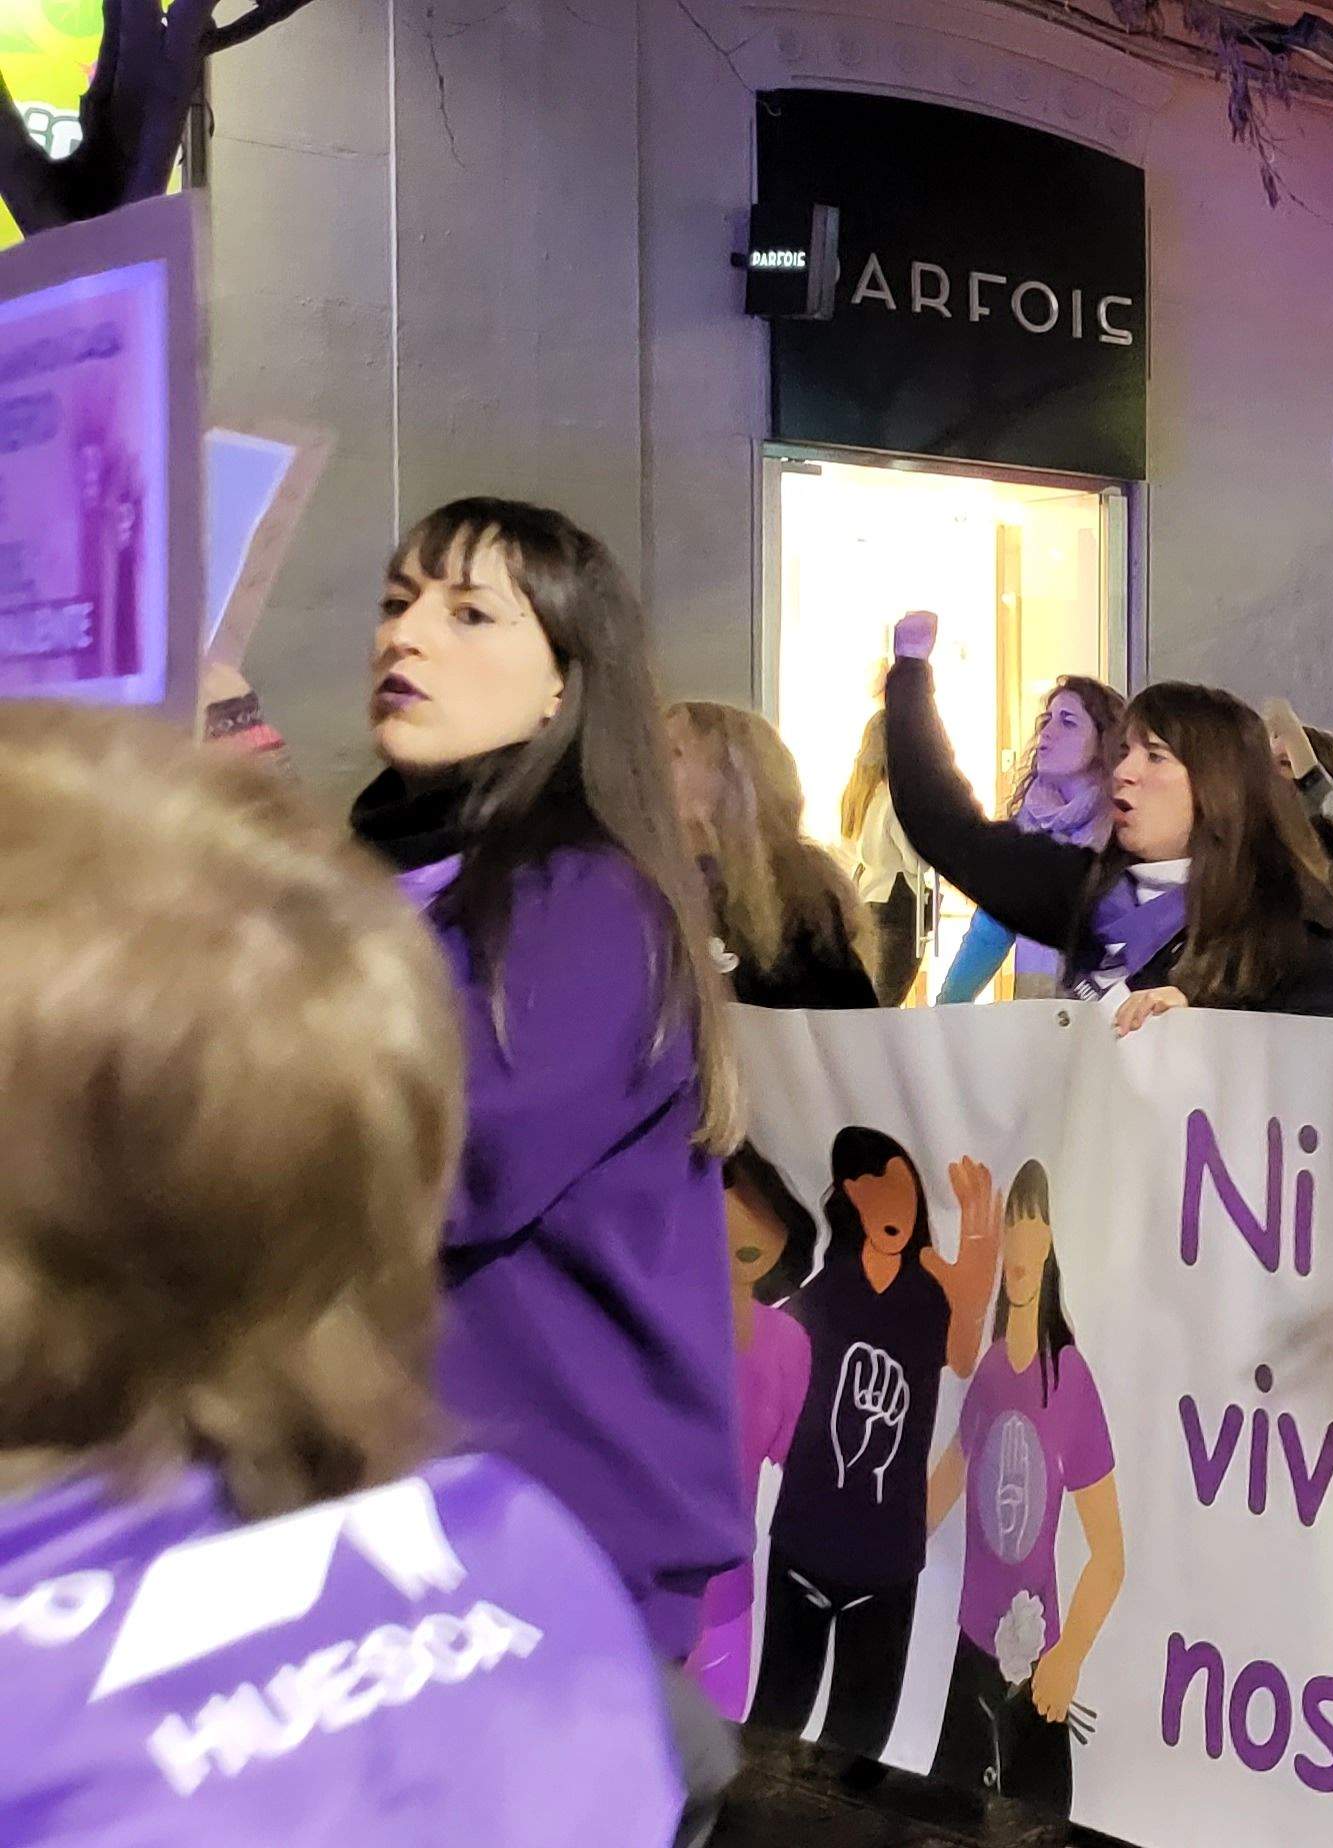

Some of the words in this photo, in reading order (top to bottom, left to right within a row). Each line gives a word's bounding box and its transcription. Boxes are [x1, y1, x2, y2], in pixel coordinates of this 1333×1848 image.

[751, 250, 806, 268] PARFOIS
[836, 252, 1133, 346] ARFOIS
[1179, 1107, 1319, 1278] Ni
[146, 1599, 543, 1798] HUESCA
